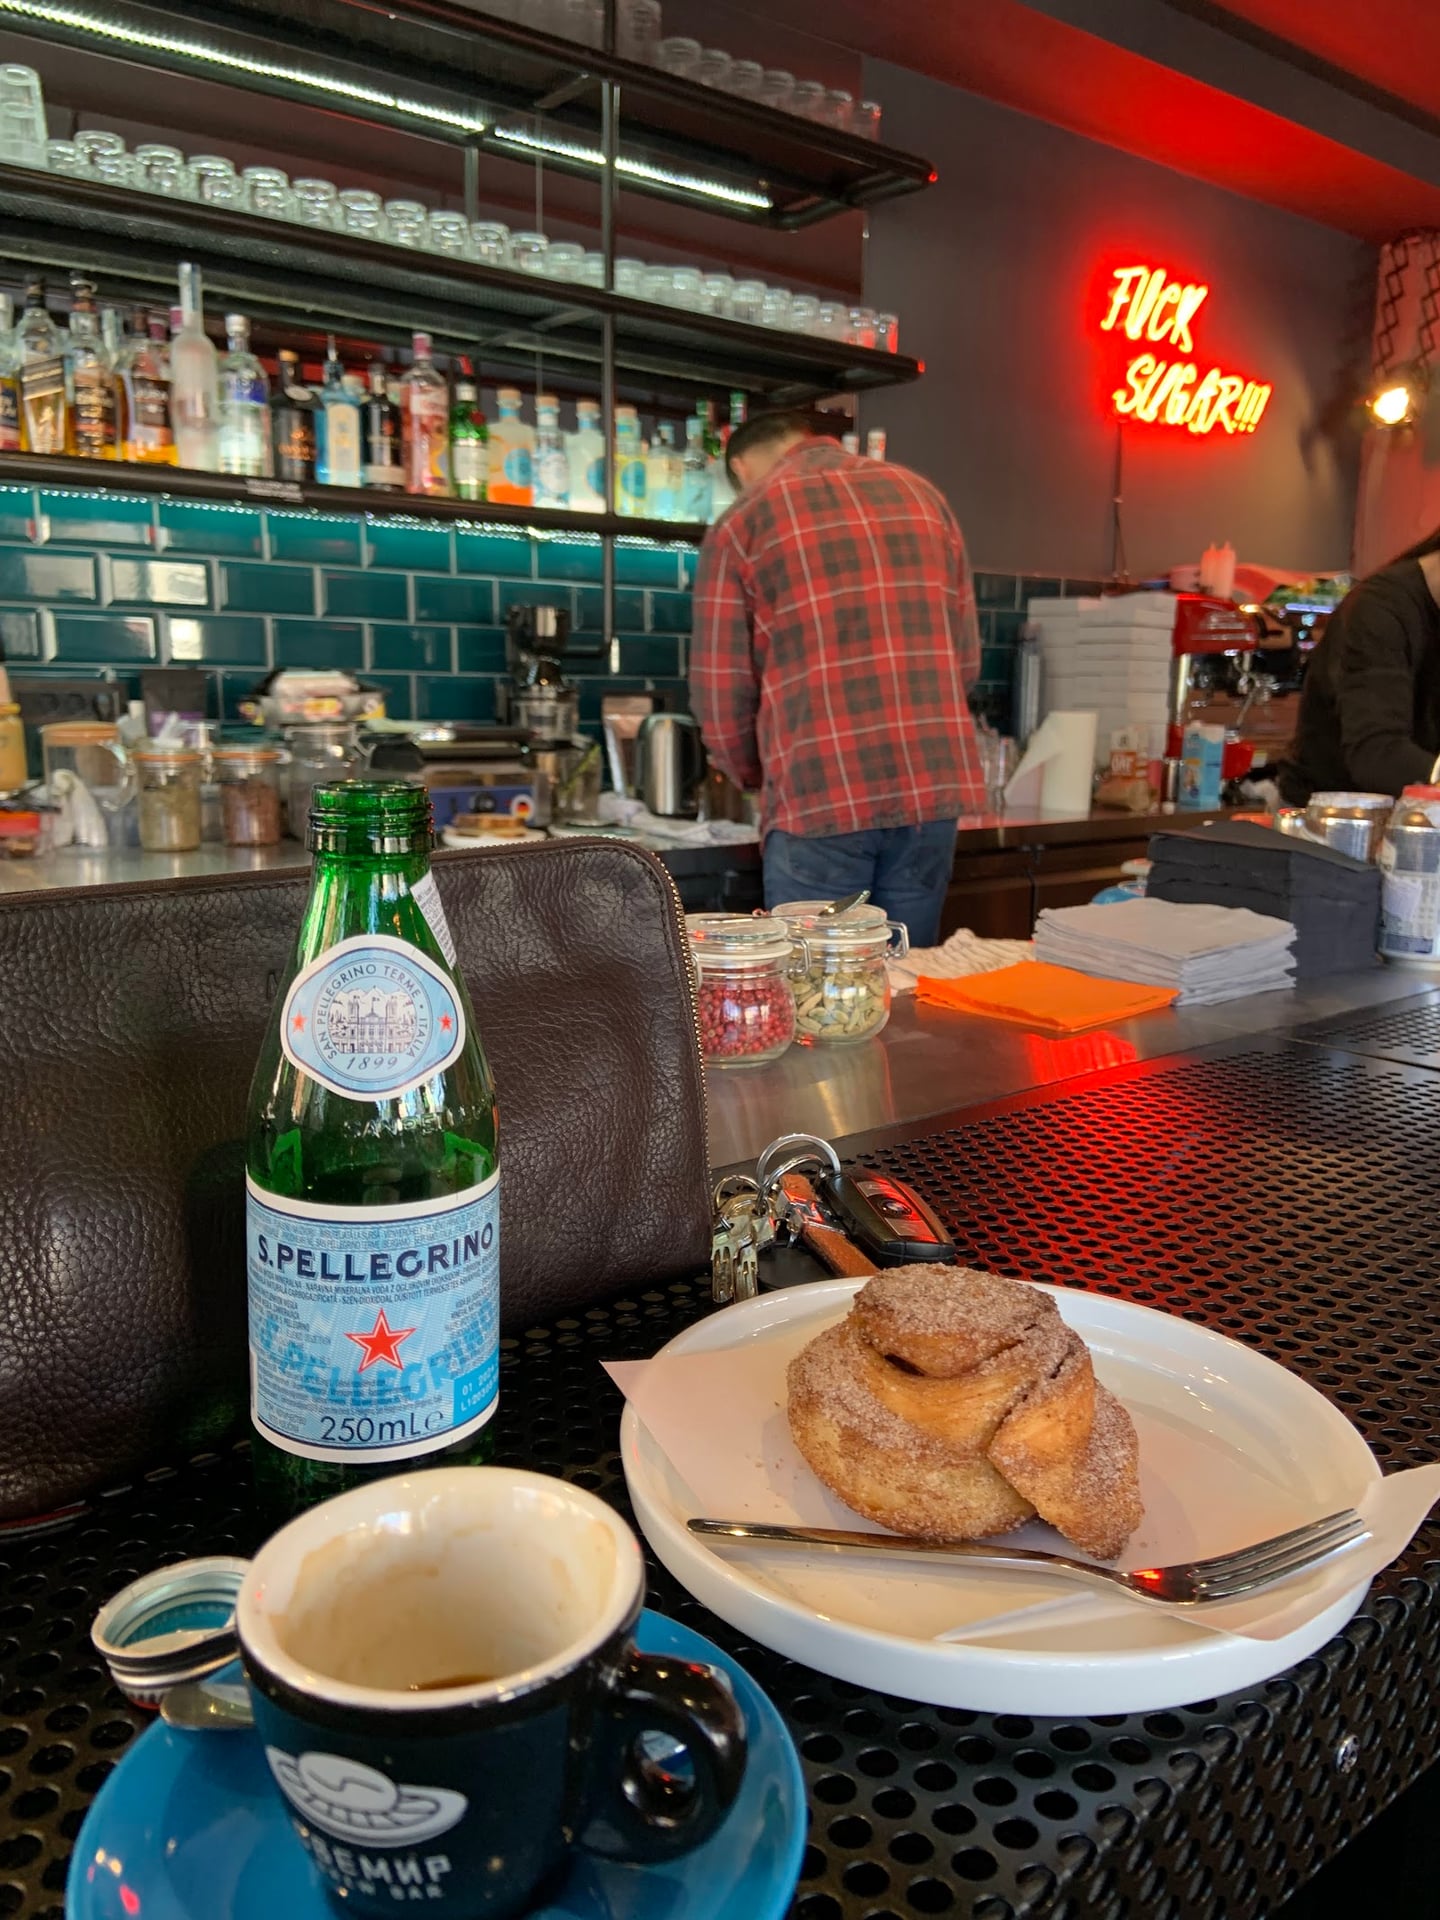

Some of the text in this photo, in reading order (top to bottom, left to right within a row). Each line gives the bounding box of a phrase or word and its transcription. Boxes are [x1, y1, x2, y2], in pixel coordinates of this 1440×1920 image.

[1100, 265, 1209, 354] FUCK
[1112, 352, 1273, 434] SUGAR!!!
[317, 963, 377, 1025] PELLEGRINO
[383, 965, 421, 999] TERME
[317, 1030, 338, 1060] SAN
[346, 1056, 398, 1070] 1899
[406, 1018, 428, 1058] ITALIA
[258, 1222, 494, 1282] S.PELLEGRINO
